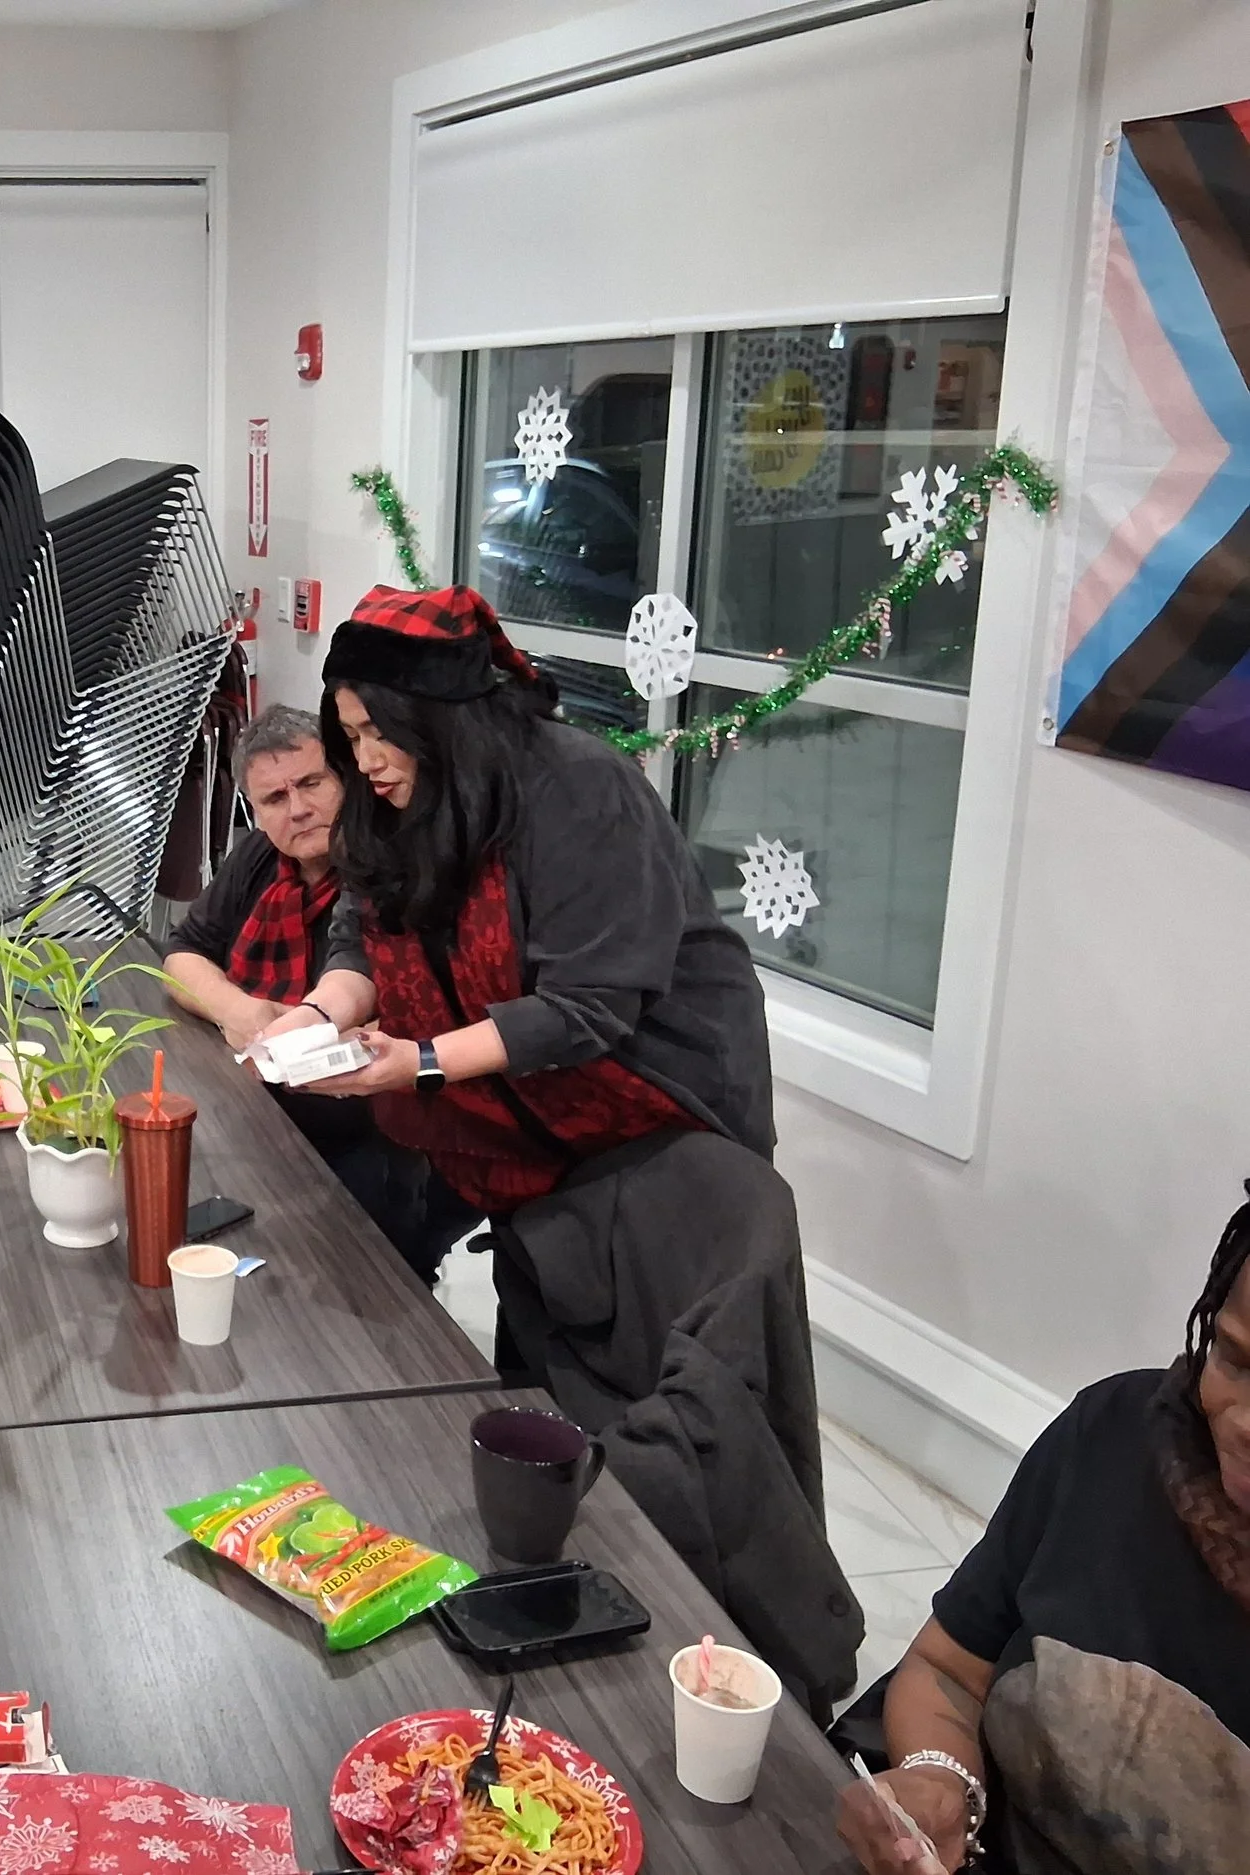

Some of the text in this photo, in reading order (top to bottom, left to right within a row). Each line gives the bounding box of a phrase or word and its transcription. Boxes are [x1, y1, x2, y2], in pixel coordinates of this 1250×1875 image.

[234, 1486, 318, 1536] Howard's
[319, 1569, 352, 1597] RIED
[352, 1546, 391, 1574] PORK
